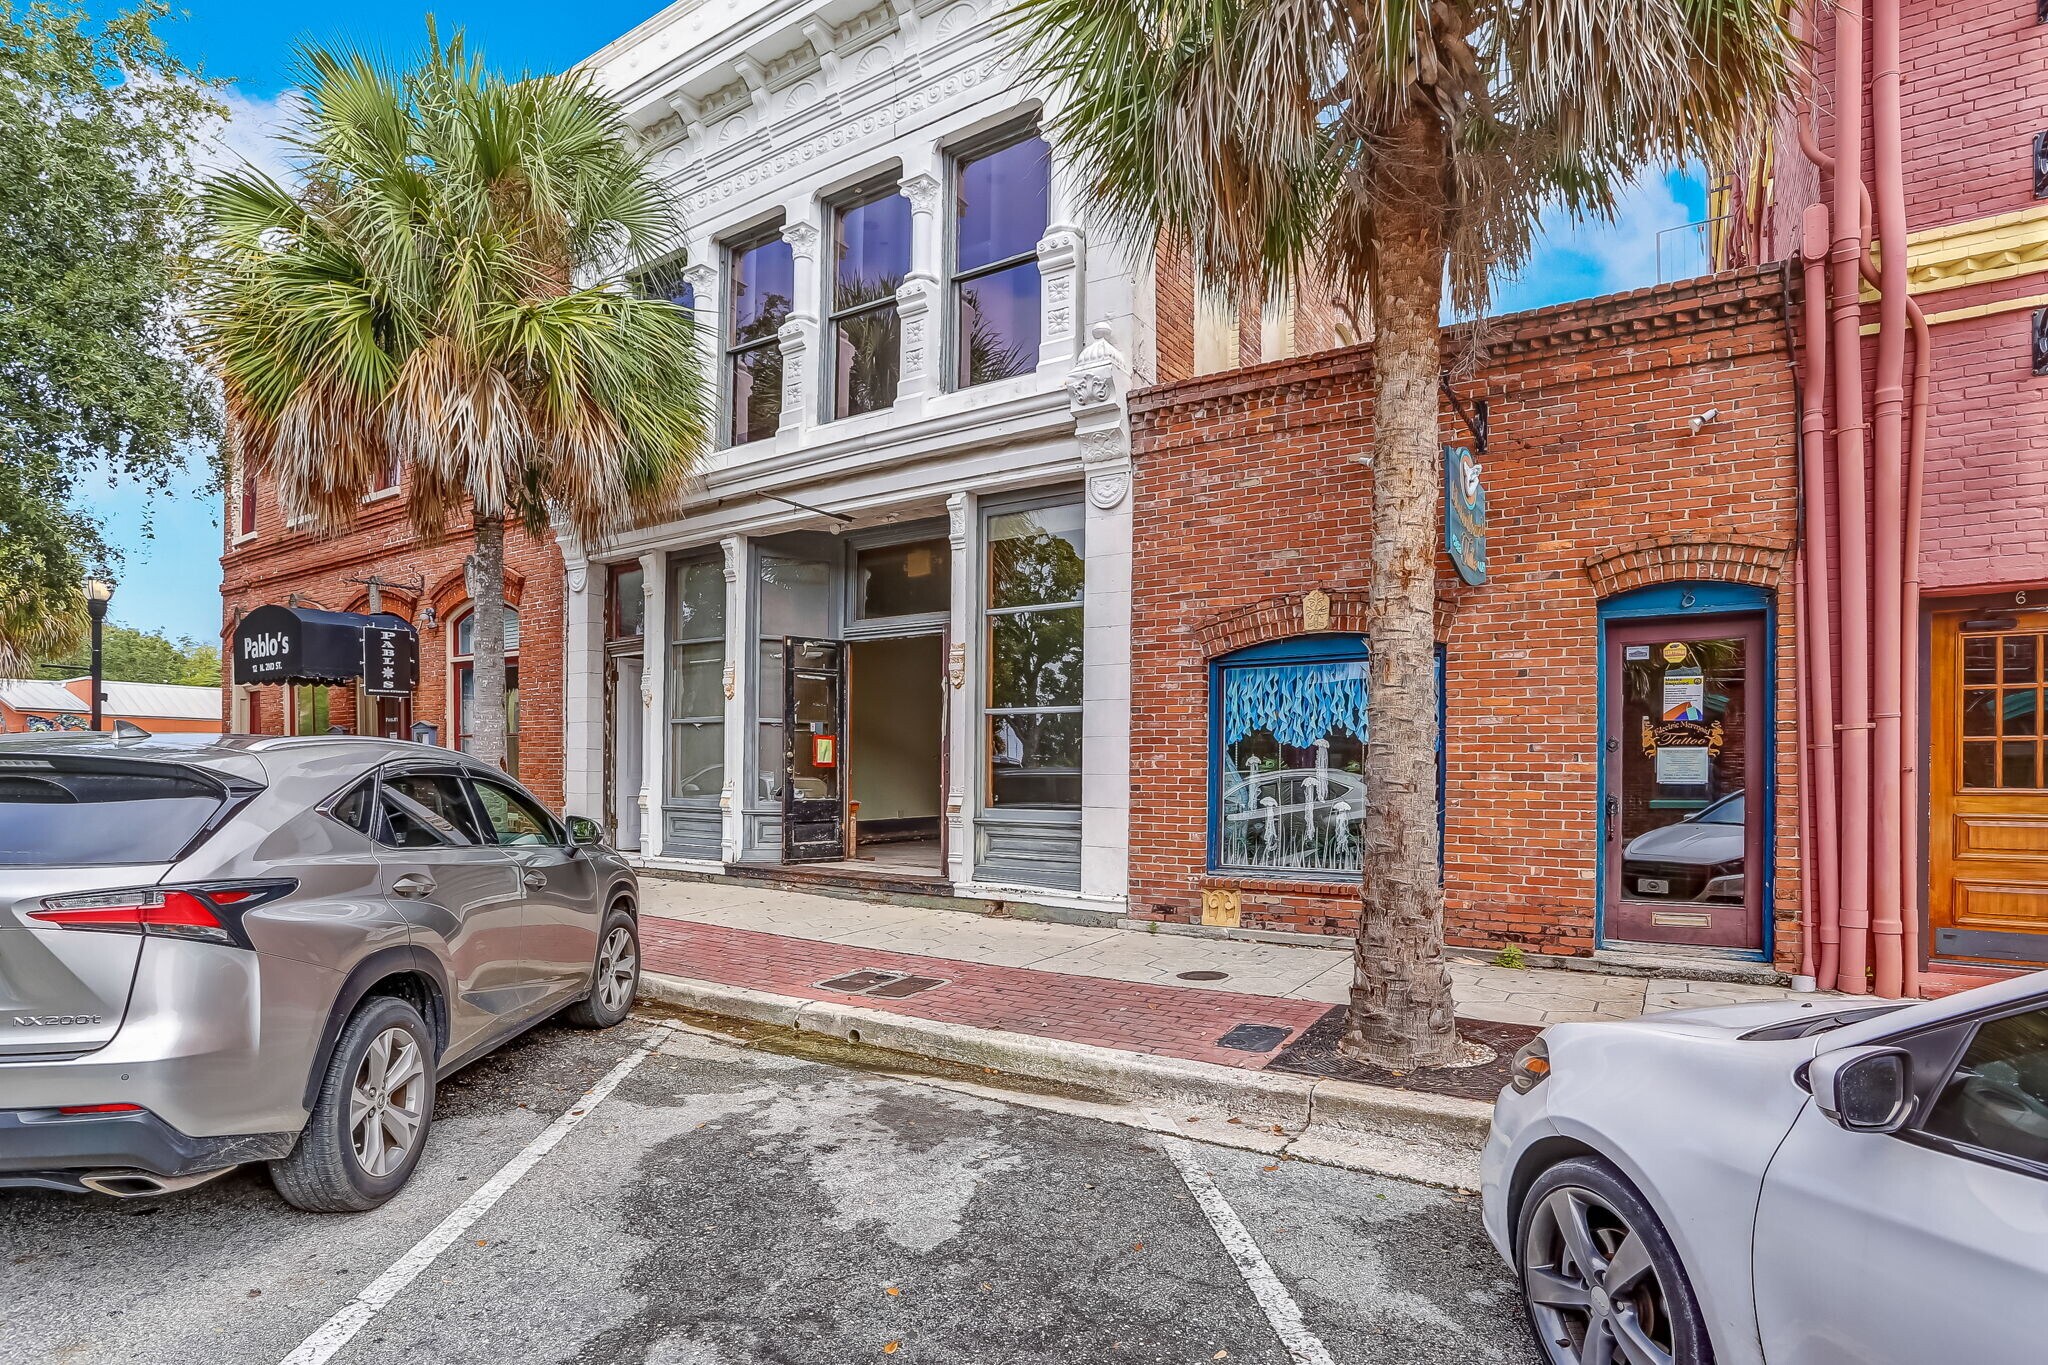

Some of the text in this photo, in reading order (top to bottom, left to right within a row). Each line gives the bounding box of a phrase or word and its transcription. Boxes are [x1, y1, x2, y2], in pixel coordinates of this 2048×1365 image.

[2015, 590, 2027, 605] 6
[243, 631, 290, 660] Pablo's
[265, 662, 275, 671] 2ND
[275, 661, 283, 670] ST.
[1654, 720, 1711, 736] Electric Mermaid
[1657, 732, 1707, 746] Tattoo
